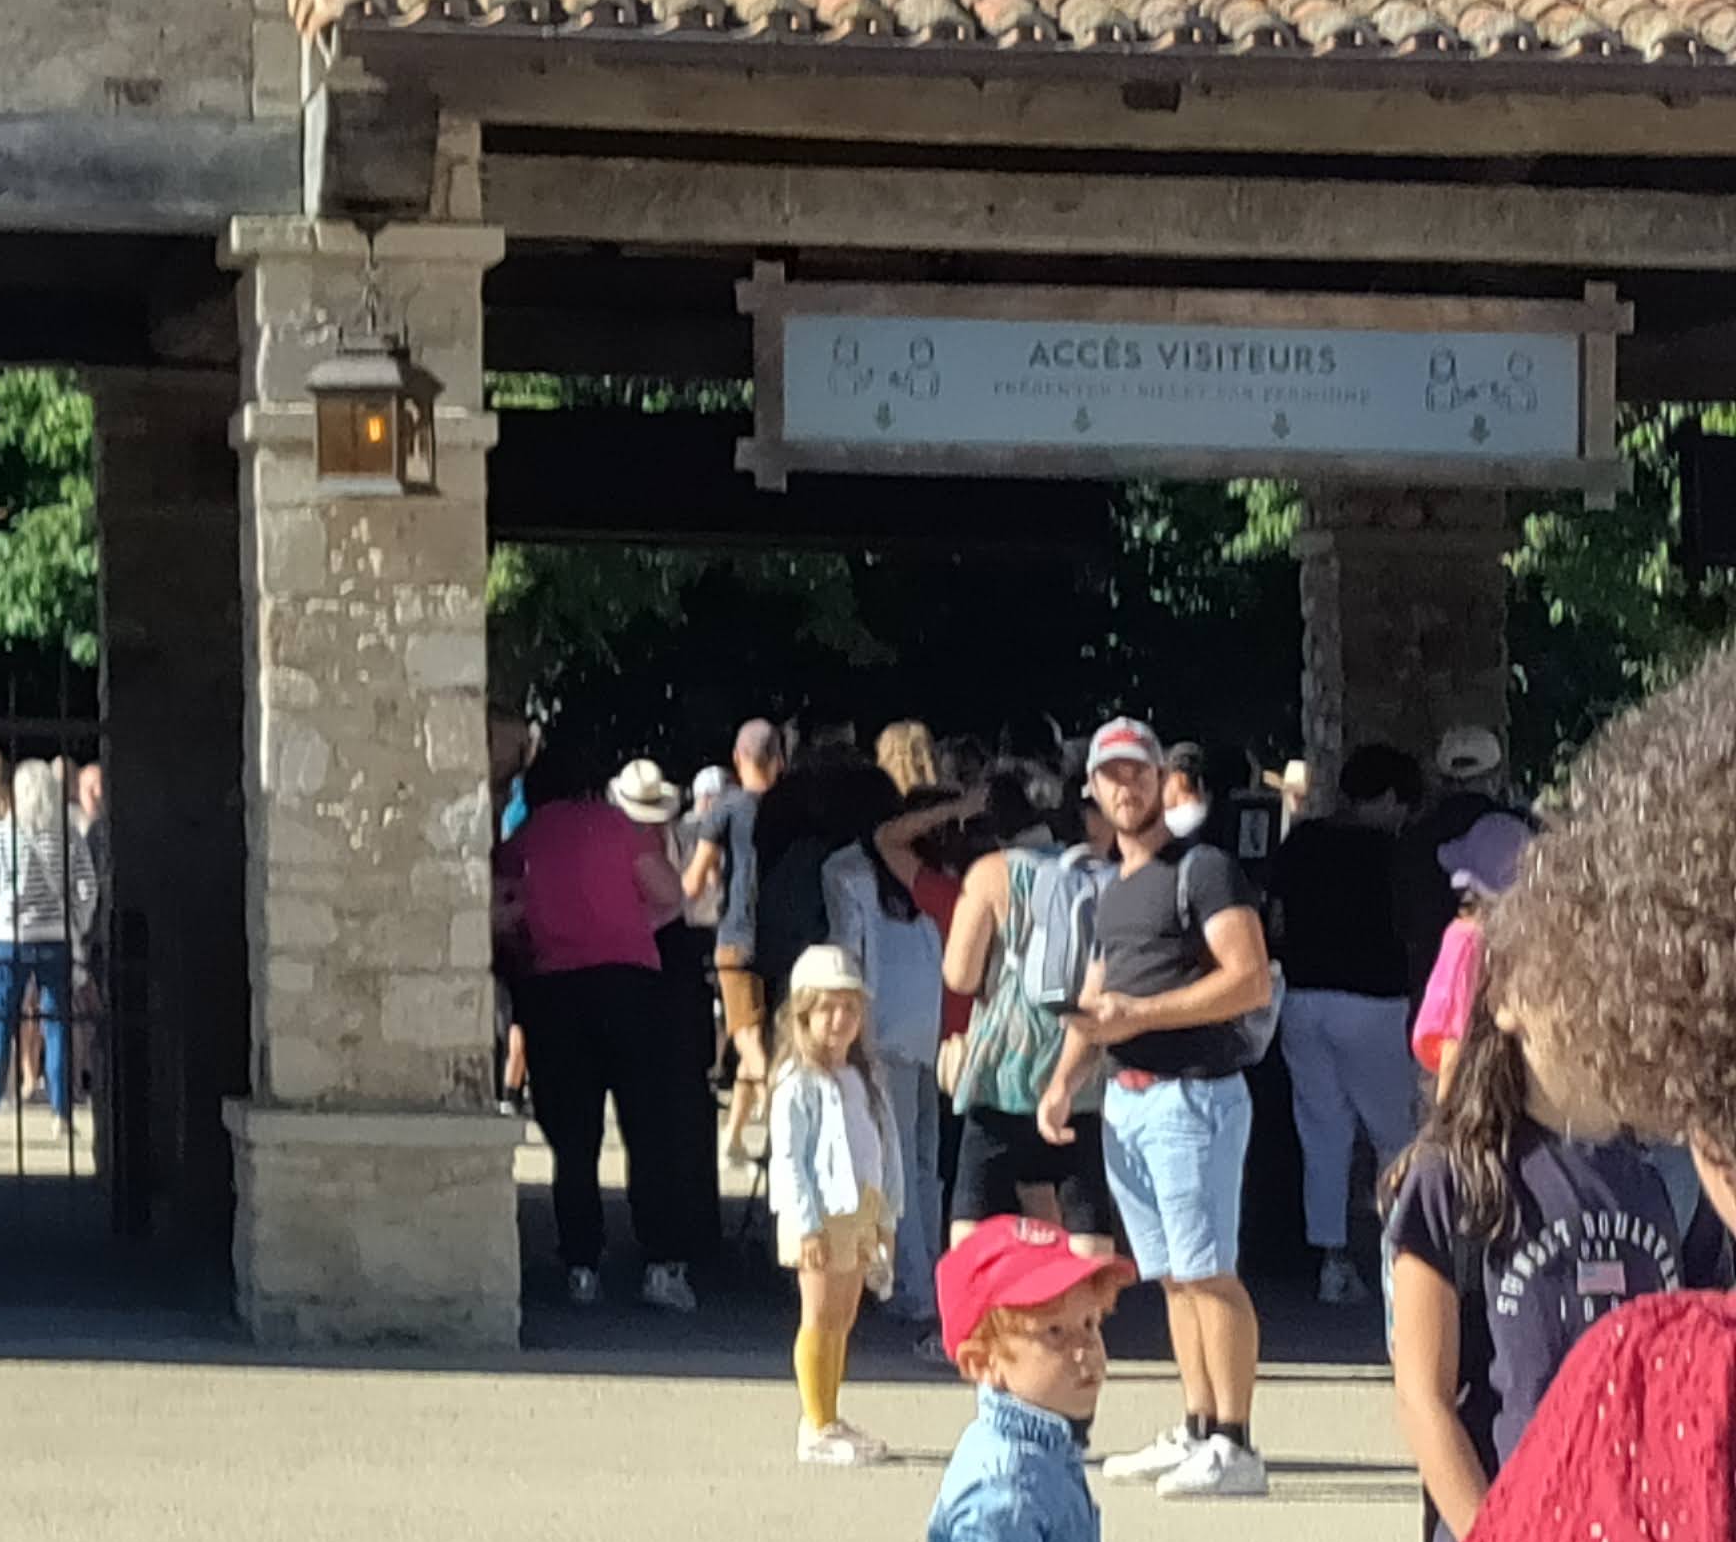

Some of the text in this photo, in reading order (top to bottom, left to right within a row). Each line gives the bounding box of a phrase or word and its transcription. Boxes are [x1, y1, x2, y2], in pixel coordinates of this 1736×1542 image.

[1028, 336, 1337, 376] ACCÈS VISITEURS
[1582, 1211, 1679, 1294] BOULEVAR
